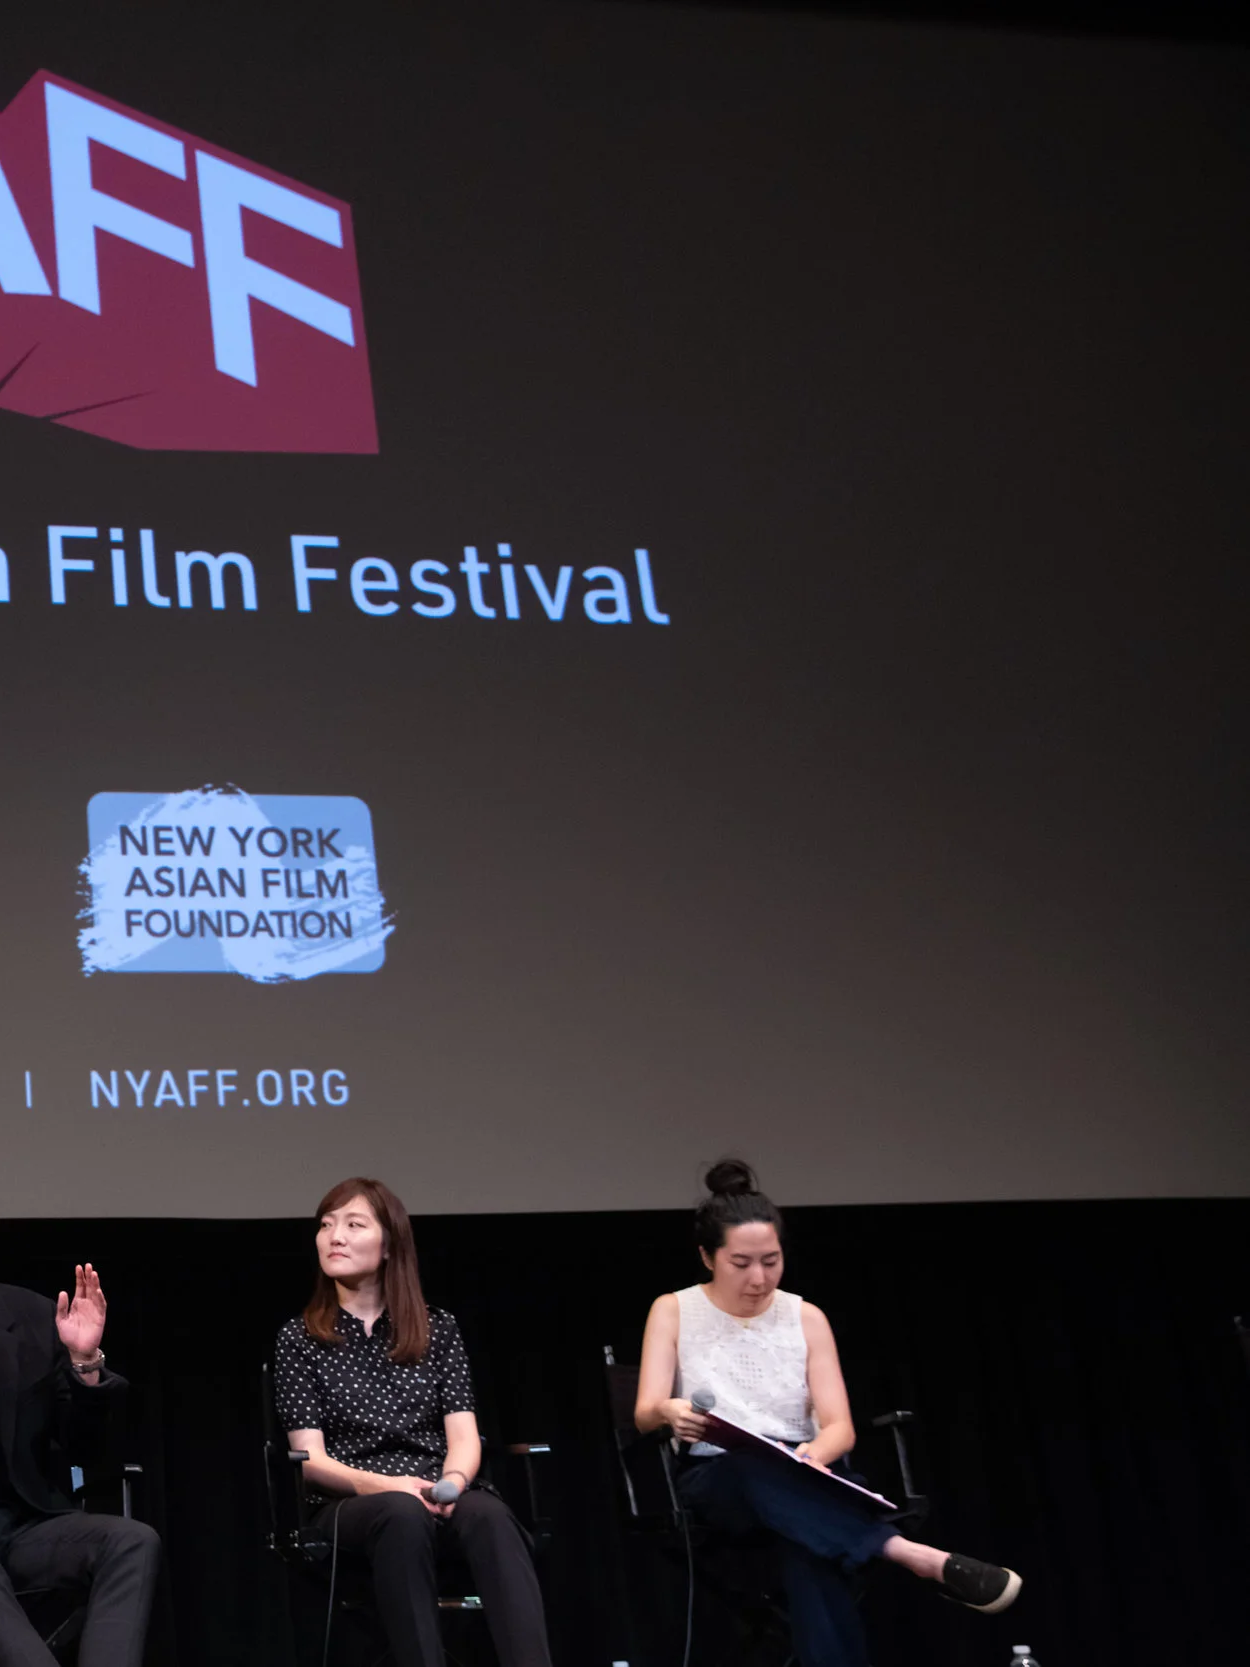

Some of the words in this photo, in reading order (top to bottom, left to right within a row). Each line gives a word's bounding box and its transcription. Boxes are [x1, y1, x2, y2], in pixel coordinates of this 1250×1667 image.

[47, 525, 258, 611] Film
[290, 534, 670, 625] Festival
[119, 825, 215, 857] NEW
[228, 826, 344, 858] YORK
[124, 866, 246, 898] ASIAN
[262, 868, 350, 899] FILM
[125, 909, 353, 939] FOUNDATION
[89, 1069, 349, 1109] NYAFF.ORG
